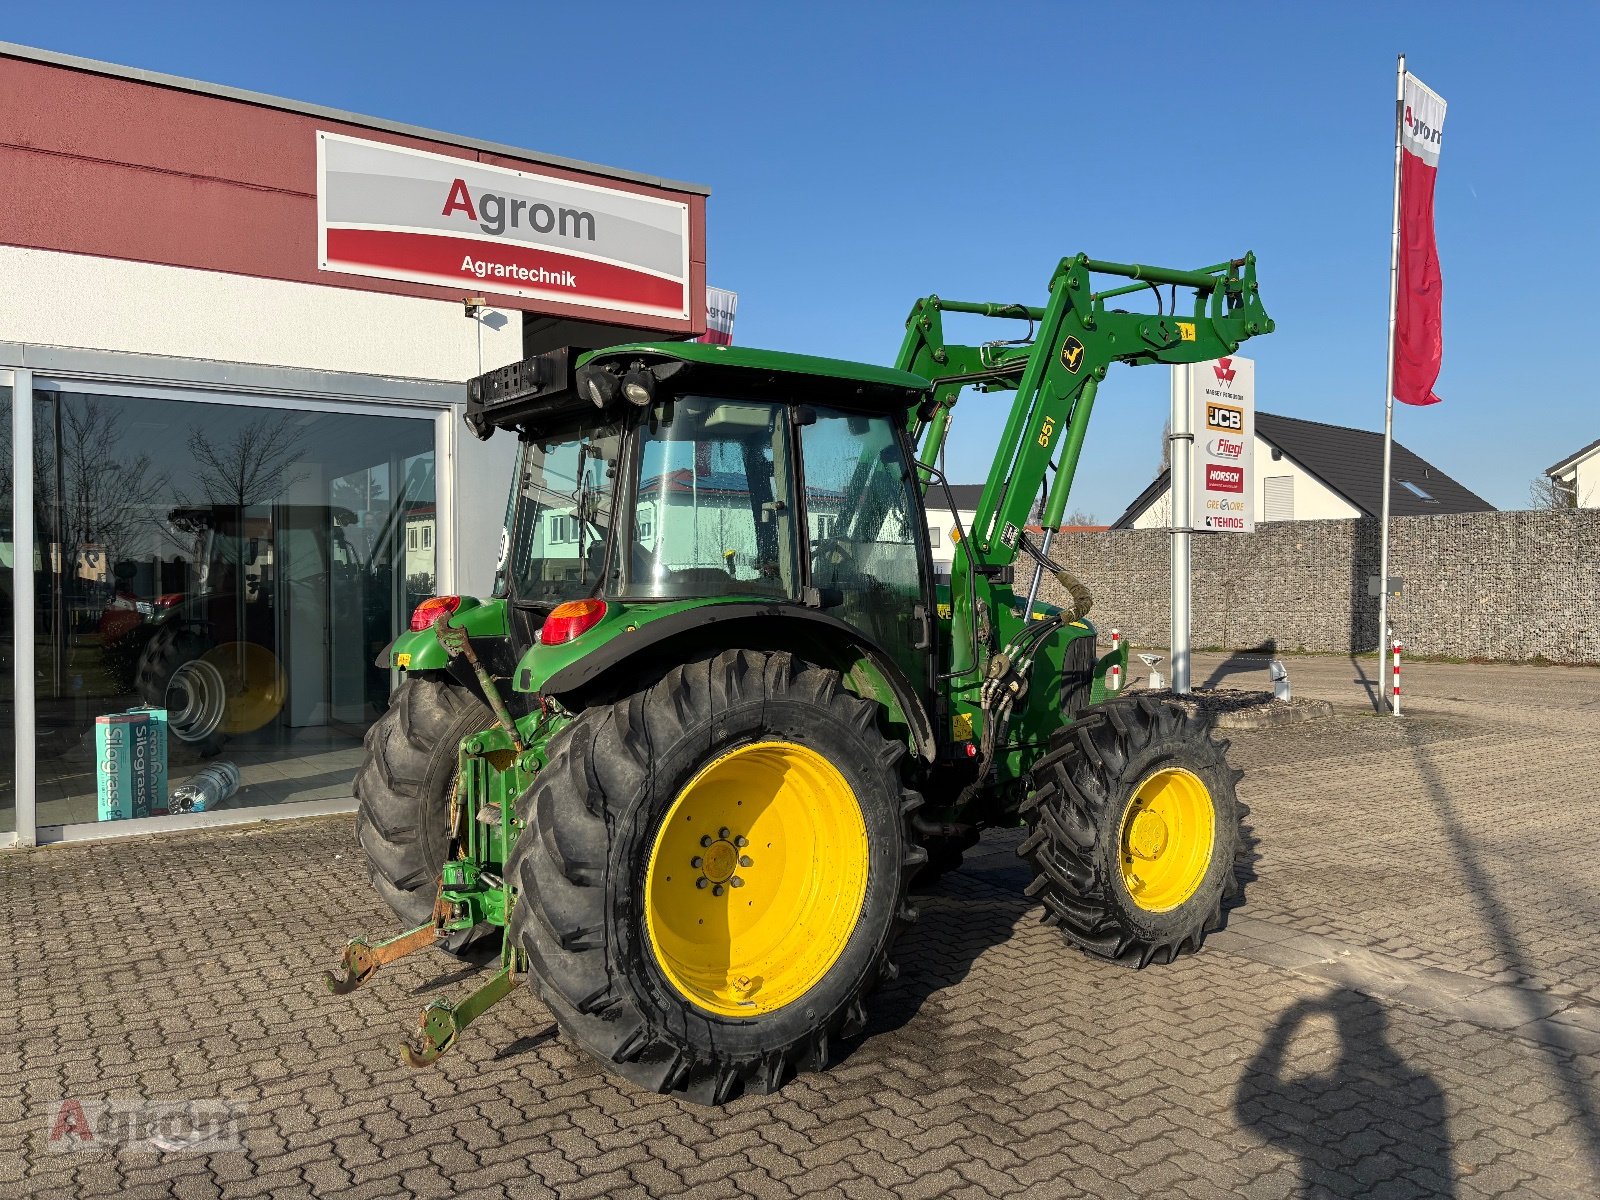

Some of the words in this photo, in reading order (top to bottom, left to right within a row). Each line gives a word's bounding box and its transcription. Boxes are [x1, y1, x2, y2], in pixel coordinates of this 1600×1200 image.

[441, 178, 596, 241] Agrom
[460, 255, 577, 288] Agrartechnik
[706, 306, 735, 321] grom
[1209, 408, 1242, 429] JCB
[1038, 415, 1056, 448] 551
[1217, 438, 1244, 458] Fliegl
[1209, 470, 1240, 483] HORSCH
[1206, 498, 1244, 511] GREGOIRE
[1212, 516, 1244, 529] TEHNOS
[101, 727, 123, 808] Silograss
[134, 724, 147, 806] Silograss
